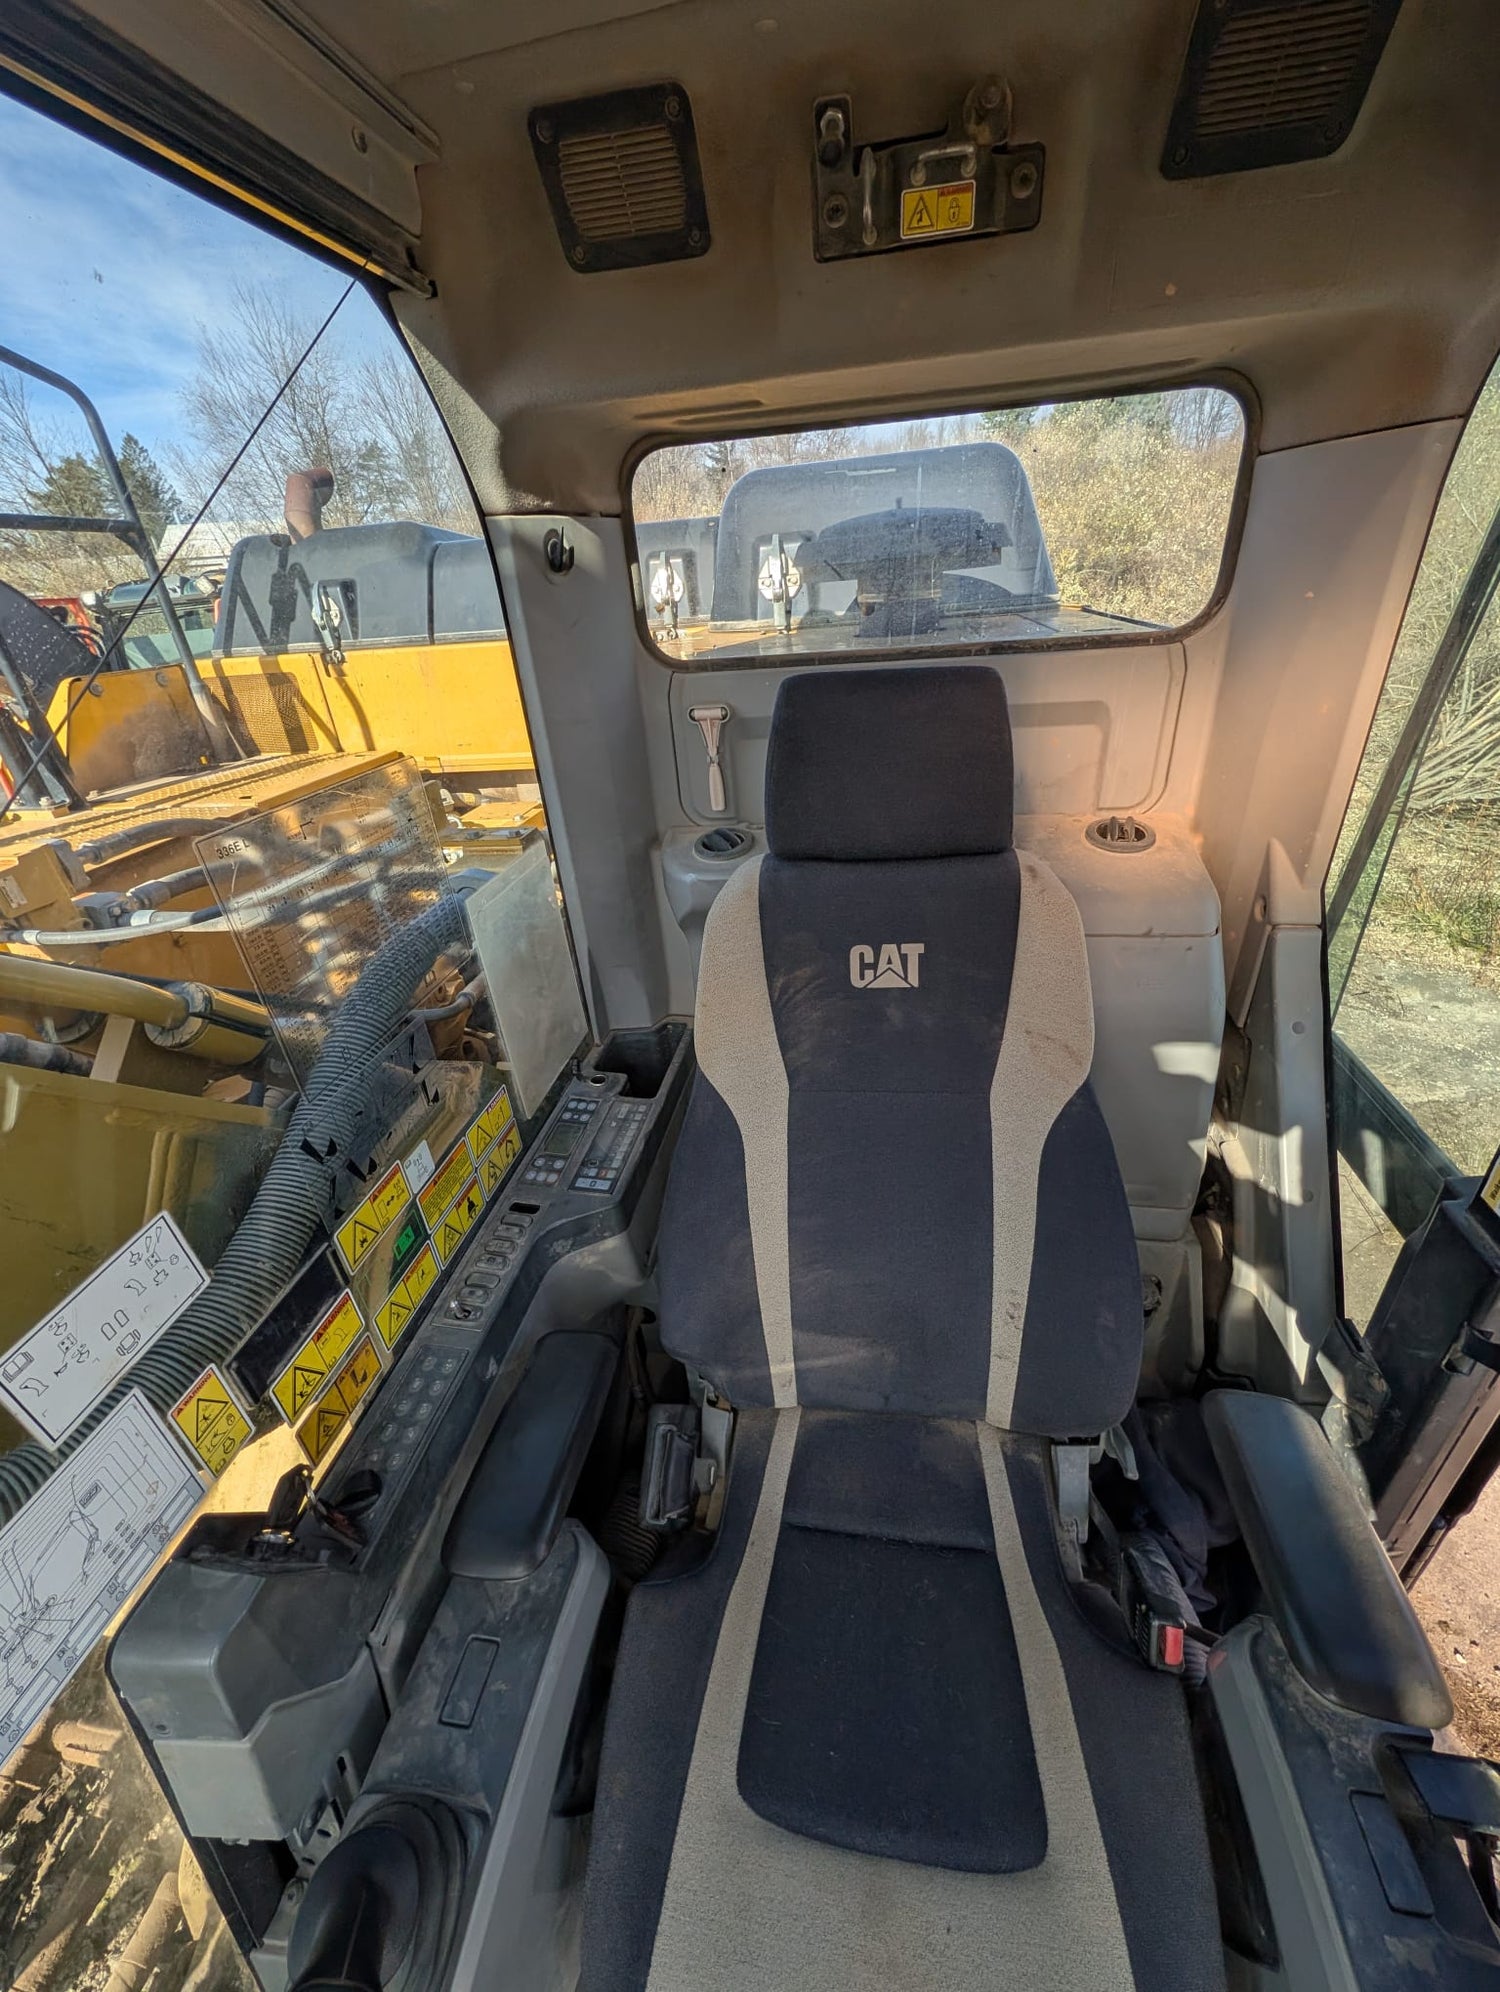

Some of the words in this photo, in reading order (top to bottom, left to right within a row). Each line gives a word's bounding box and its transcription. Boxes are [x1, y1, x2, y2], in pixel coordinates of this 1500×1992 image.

[216, 841, 242, 859] 336E
[243, 839, 251, 849] L
[849, 943, 925, 988] CAT
[183, 1373, 212, 1407] WARNING
